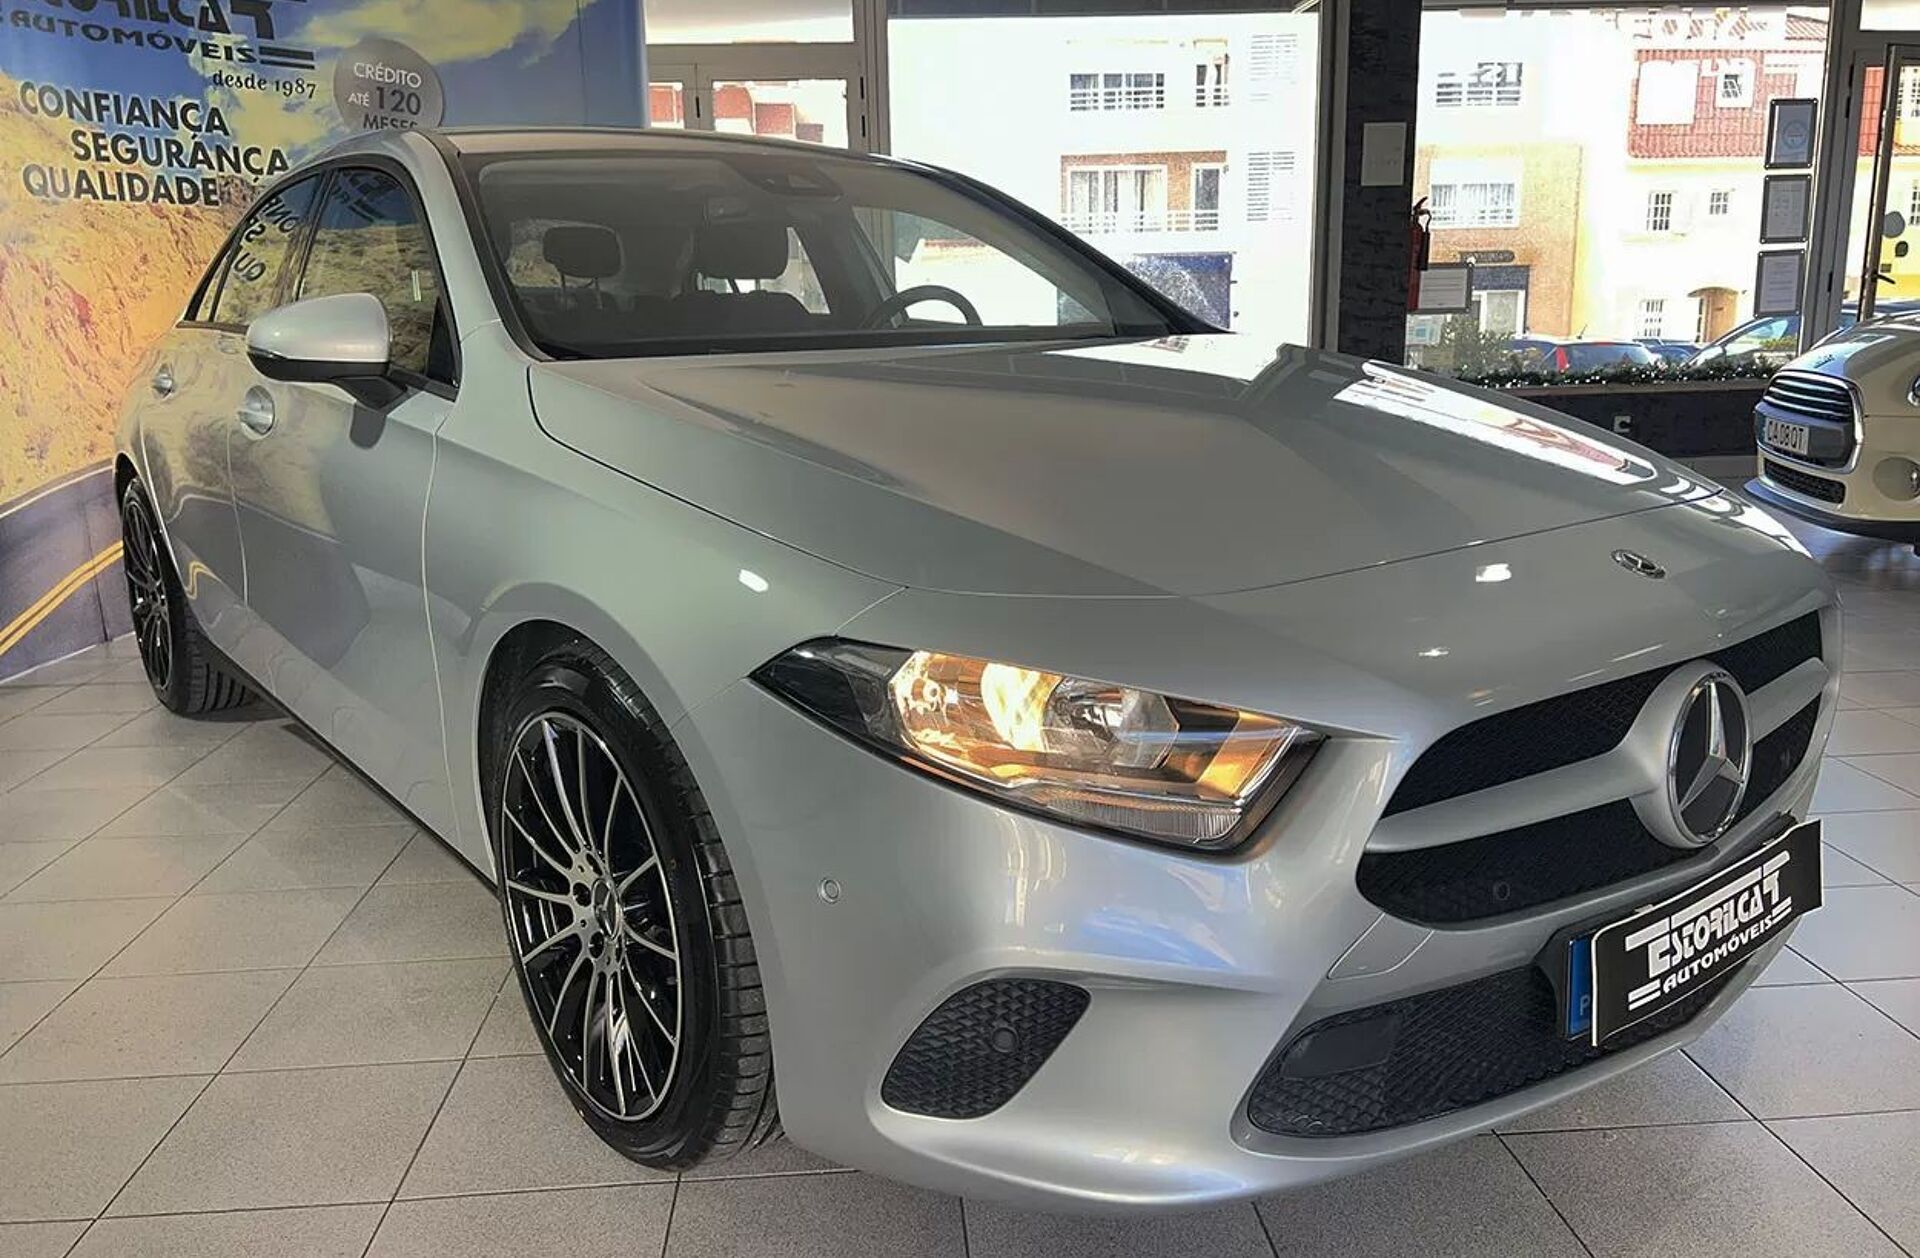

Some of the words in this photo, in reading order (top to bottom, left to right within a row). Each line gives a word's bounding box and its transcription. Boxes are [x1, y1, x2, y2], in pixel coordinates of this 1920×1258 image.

[10, 10, 257, 63] AUTOMÓVEIS
[213, 70, 267, 91] desde
[275, 80, 316, 100] 1987
[353, 62, 422, 88] CRÉDITO
[19, 81, 230, 142] CONFIANÇA
[347, 92, 370, 107] ATÉ
[376, 86, 421, 115] 120
[71, 129, 289, 183] SEGURANÇA
[22, 163, 220, 206] QUALIDADE
[1662, 914, 1774, 994] AUTOMÓVEIS
